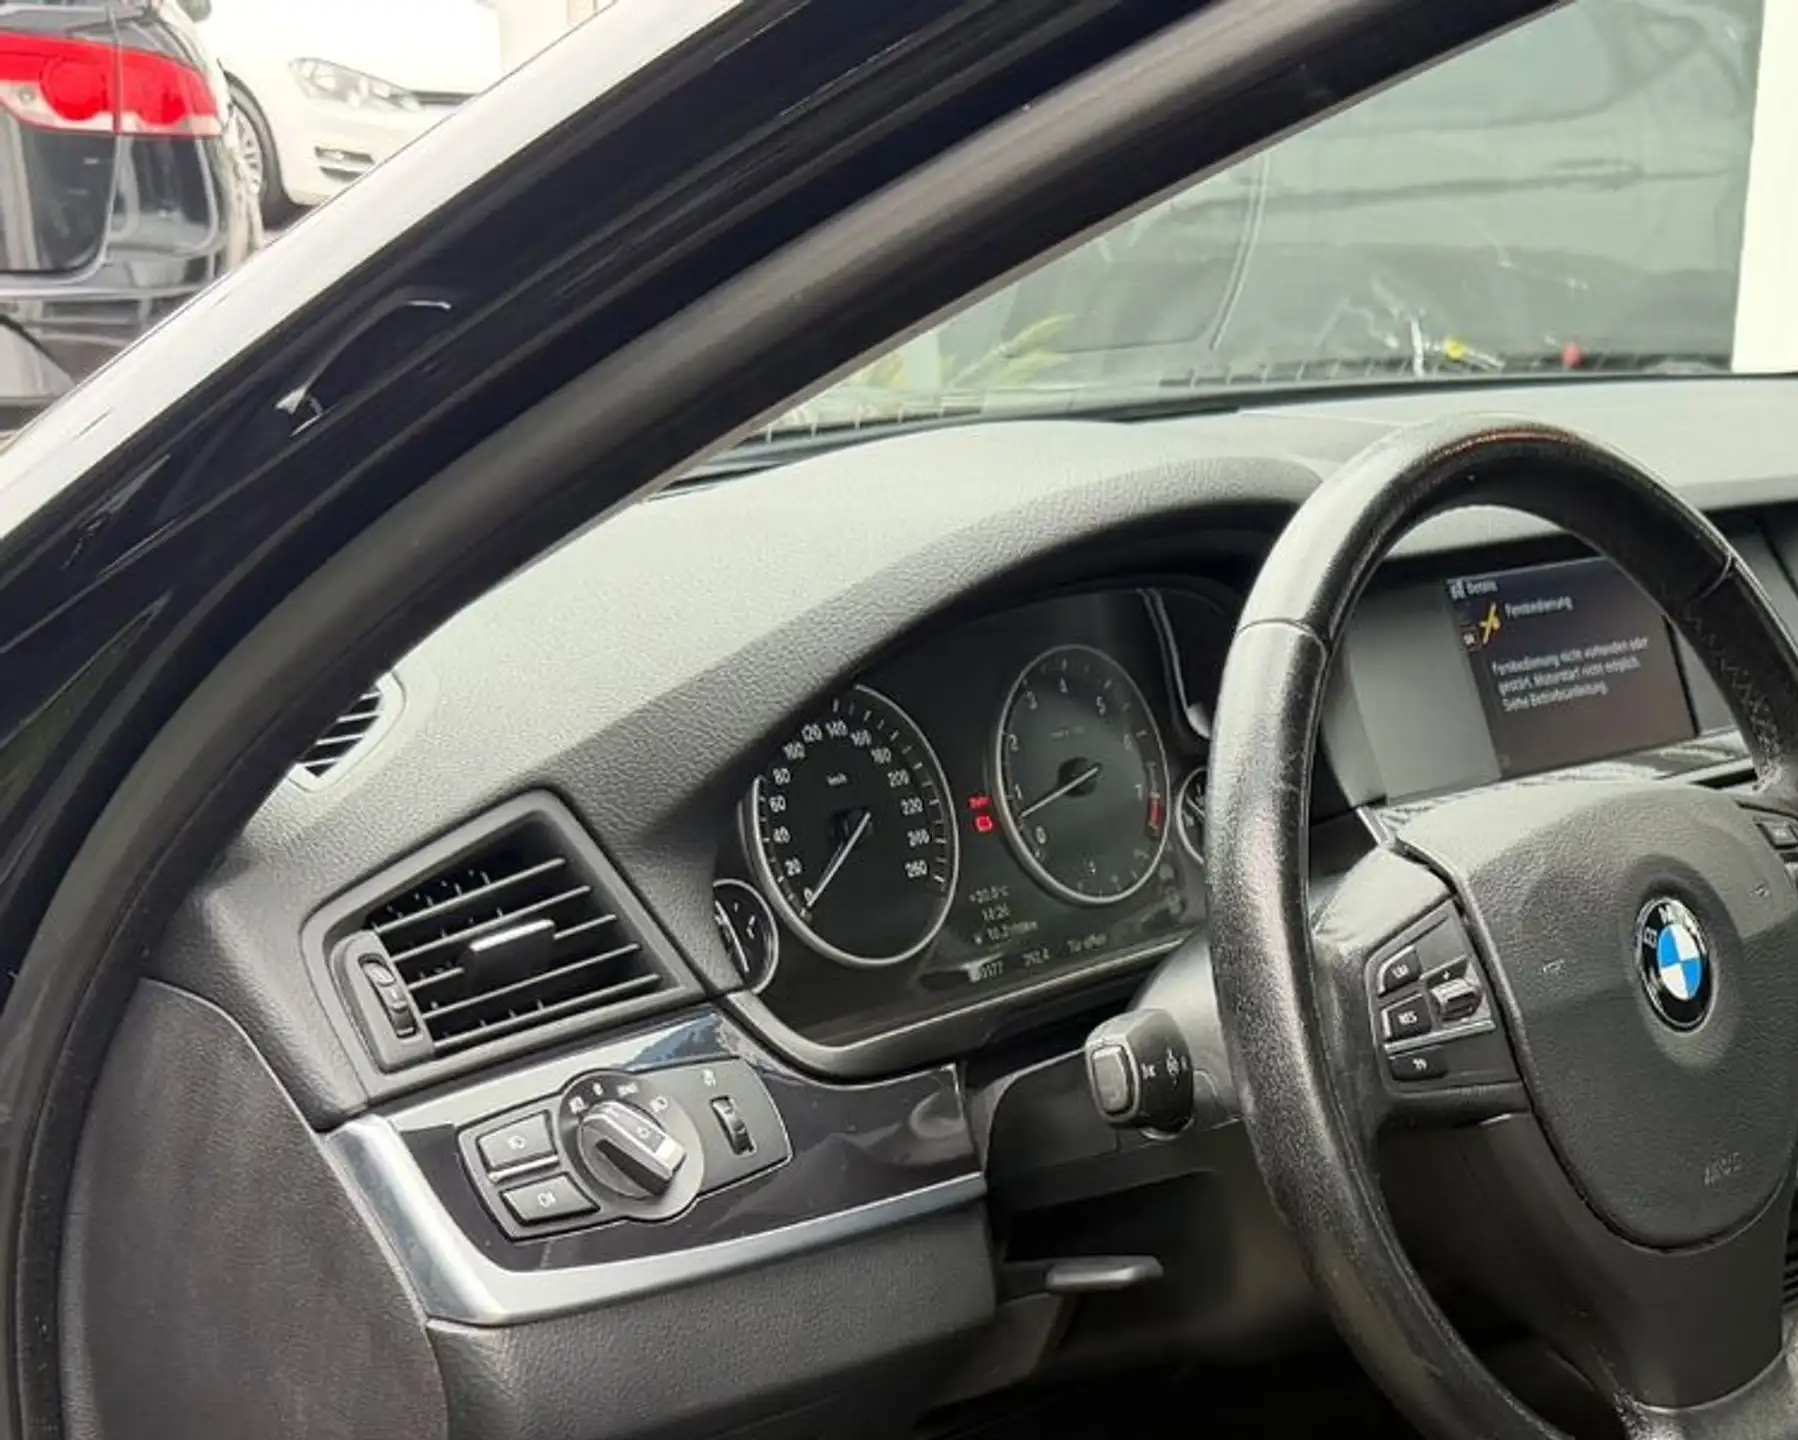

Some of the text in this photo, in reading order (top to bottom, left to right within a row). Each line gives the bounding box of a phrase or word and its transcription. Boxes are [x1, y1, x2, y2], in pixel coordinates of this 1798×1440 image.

[802, 723, 823, 743] 120
[825, 719, 848, 738] 140
[783, 740, 805, 761] 100
[773, 767, 790, 785] 80
[887, 768, 909, 788] 200
[769, 795, 786, 813] 60
[901, 797, 923, 816] 220
[773, 826, 790, 844] 40
[785, 858, 802, 876] 20
